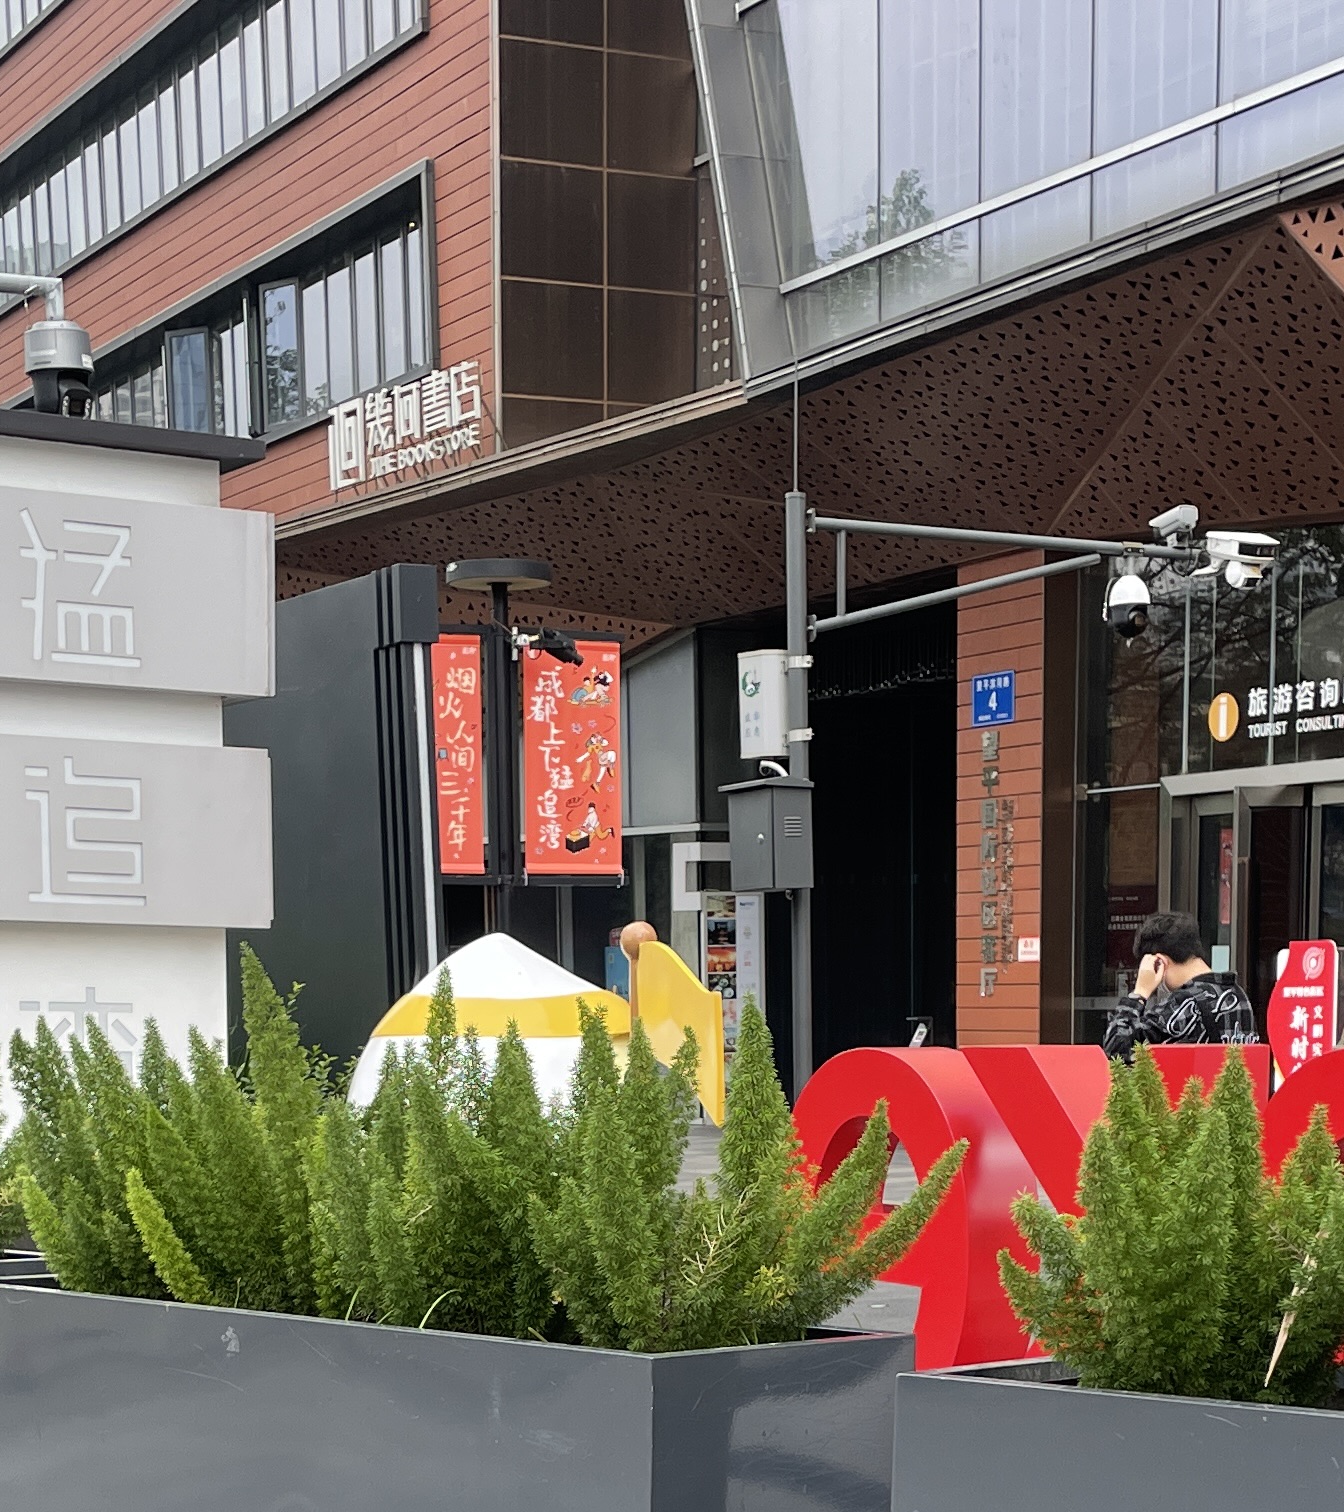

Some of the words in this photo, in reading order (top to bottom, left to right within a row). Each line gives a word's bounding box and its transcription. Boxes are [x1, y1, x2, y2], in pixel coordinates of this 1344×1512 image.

[365, 361, 482, 455] 幾何書店
[397, 424, 481, 470] BOOKSTORE
[988, 691, 998, 711] 4
[1247, 720, 1288, 739] TOURIST
[438, 666, 477, 852] 烟火人间三千年
[526, 665, 575, 850] 成都上下猛追湾
